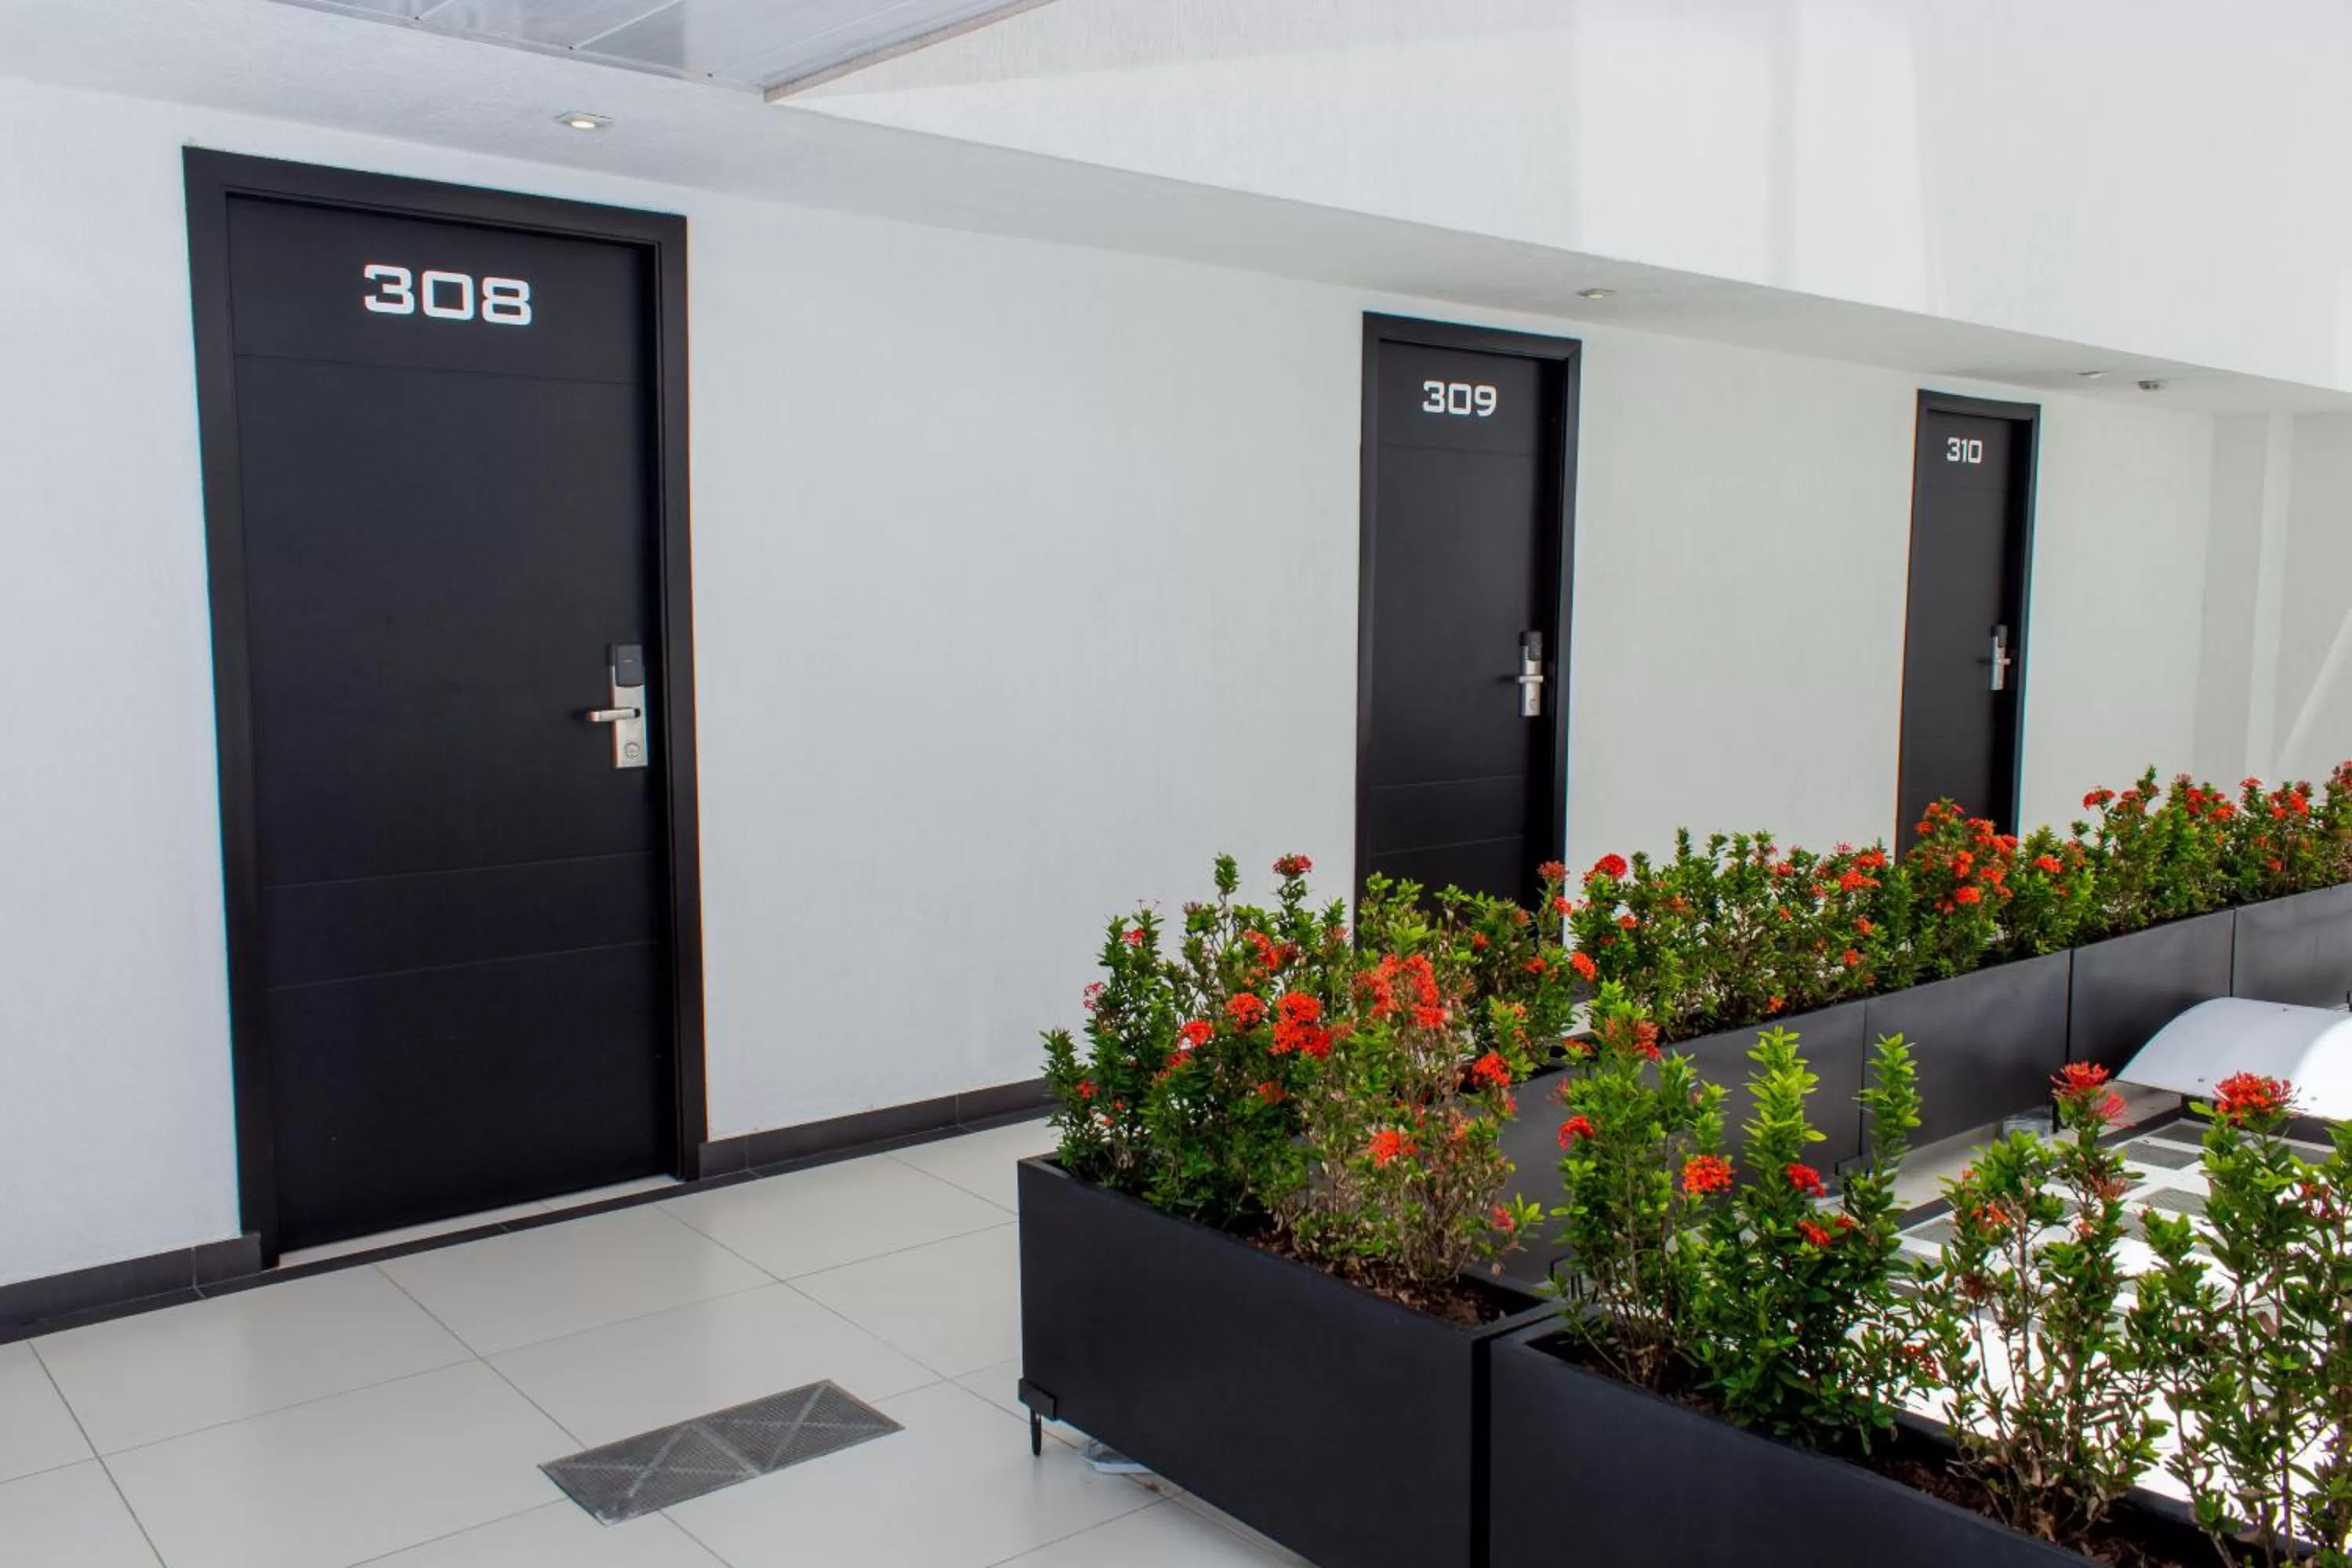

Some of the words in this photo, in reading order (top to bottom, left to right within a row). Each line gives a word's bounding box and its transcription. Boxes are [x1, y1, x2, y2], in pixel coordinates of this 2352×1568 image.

[364, 264, 532, 325] 308
[1422, 380, 1497, 417] 309
[1947, 437, 1983, 464] 310
